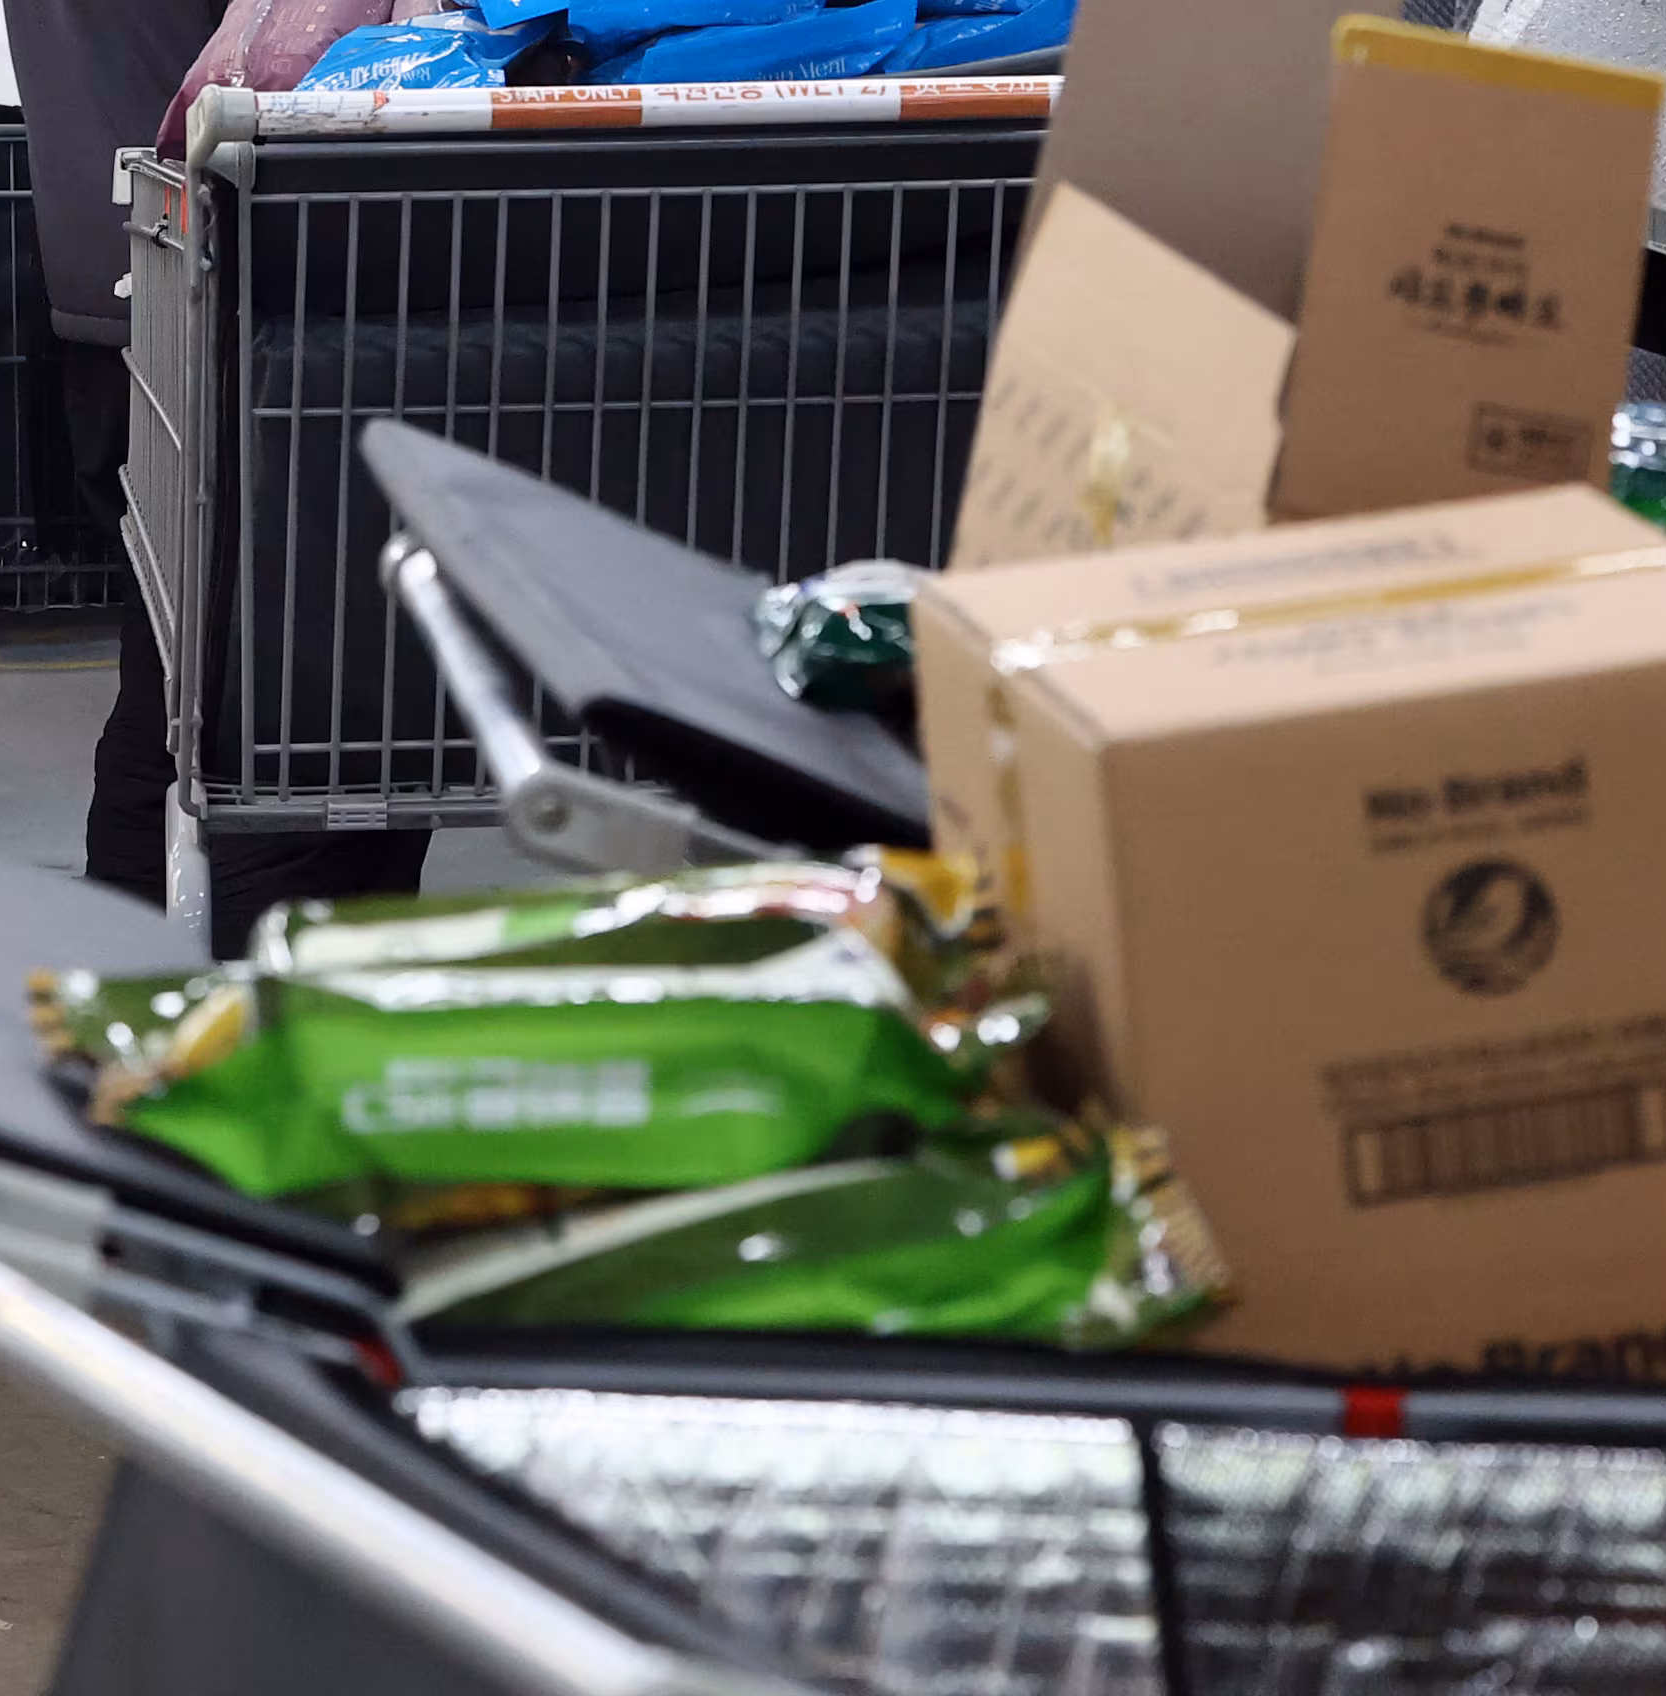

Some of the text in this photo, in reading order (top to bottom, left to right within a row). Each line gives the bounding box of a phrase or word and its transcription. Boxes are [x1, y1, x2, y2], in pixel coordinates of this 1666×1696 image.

[800, 56, 846, 79] Meat
[500, 86, 632, 104] STAFF ONLY
